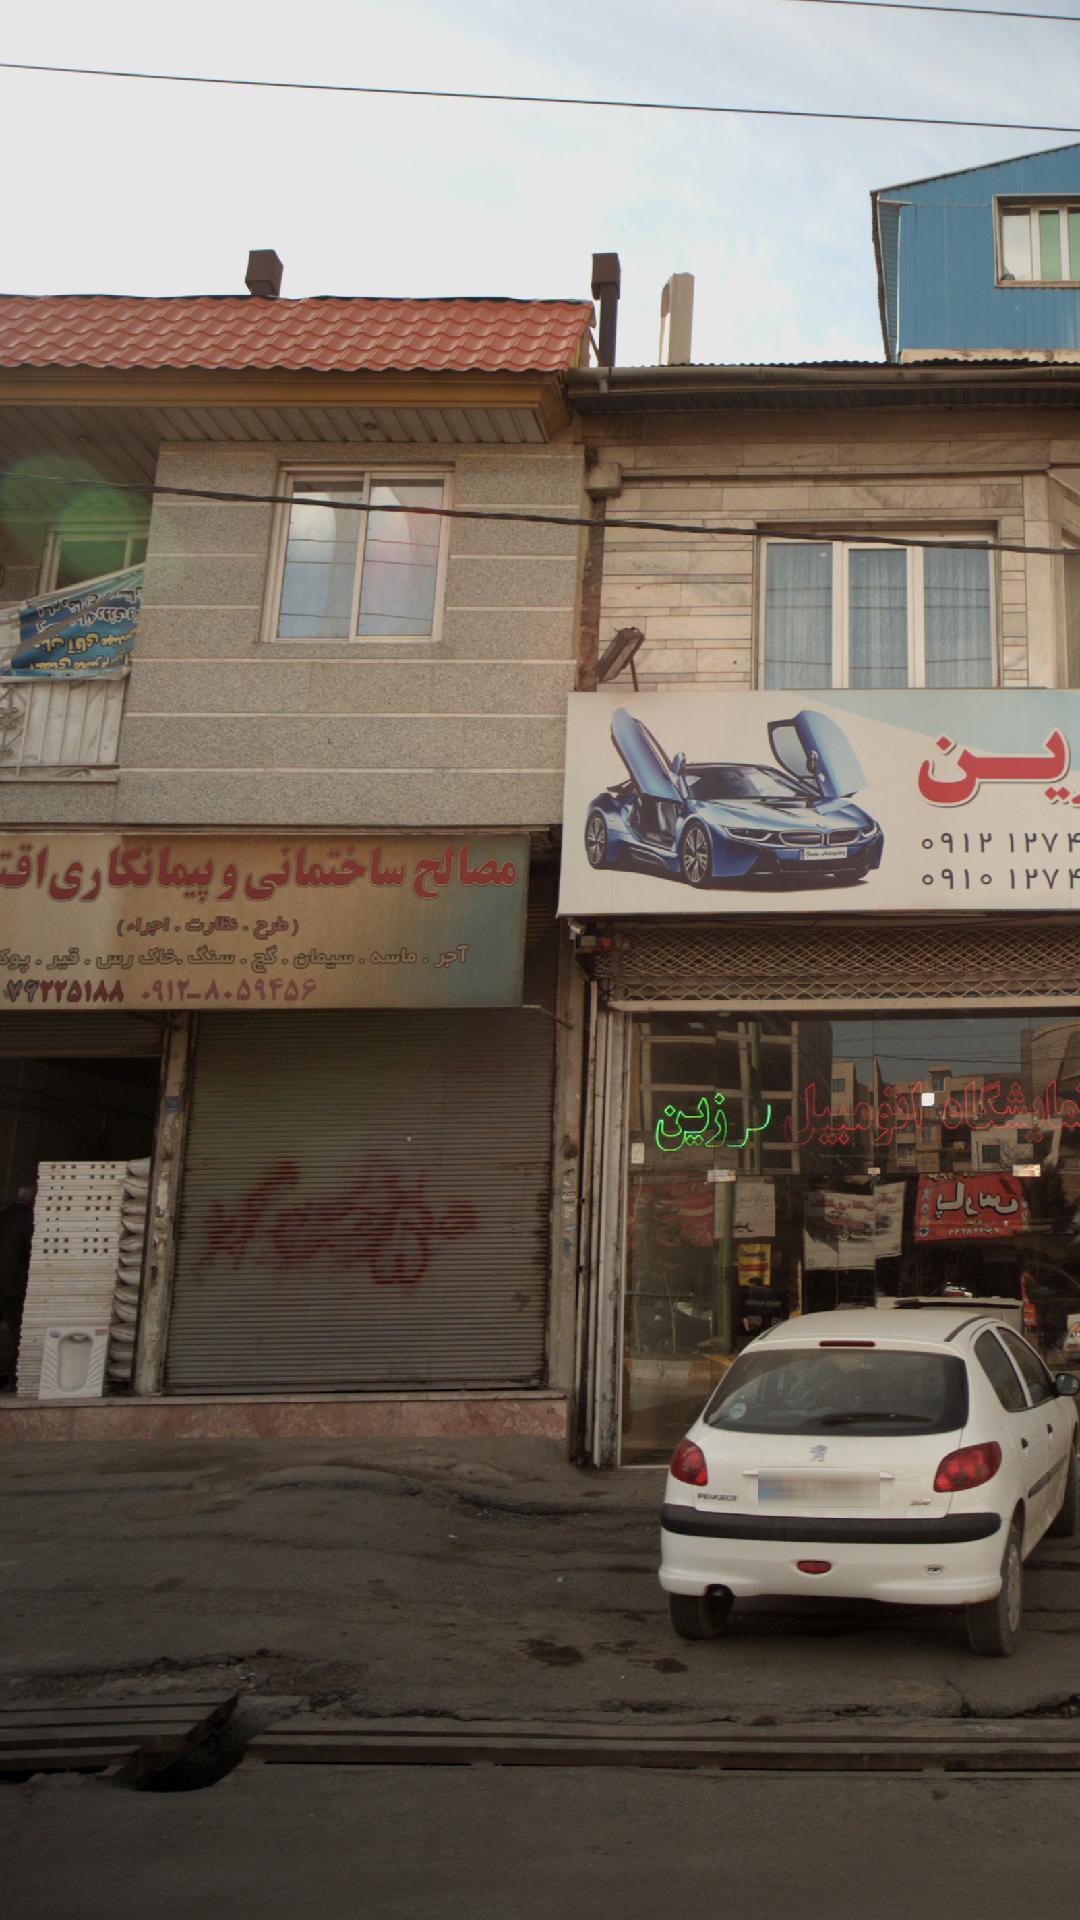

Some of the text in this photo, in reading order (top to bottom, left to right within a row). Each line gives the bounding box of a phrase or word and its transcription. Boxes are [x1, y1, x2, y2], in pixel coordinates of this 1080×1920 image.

[917, 729, 1080, 807] ین
[921, 832, 993, 853] ۰۹۱۲
[0, 843, 517, 904] مصالح ساختمانی و پیمانکاری اقت
[921, 868, 993, 890] ۰۹۱۰
[184, 915, 239, 937] نظارت
[0, 944, 469, 974] آجر ماسه سیمان گچ سنگ خاک رس قیر پوک
[942, 1079, 1080, 1145] مایشگاه
